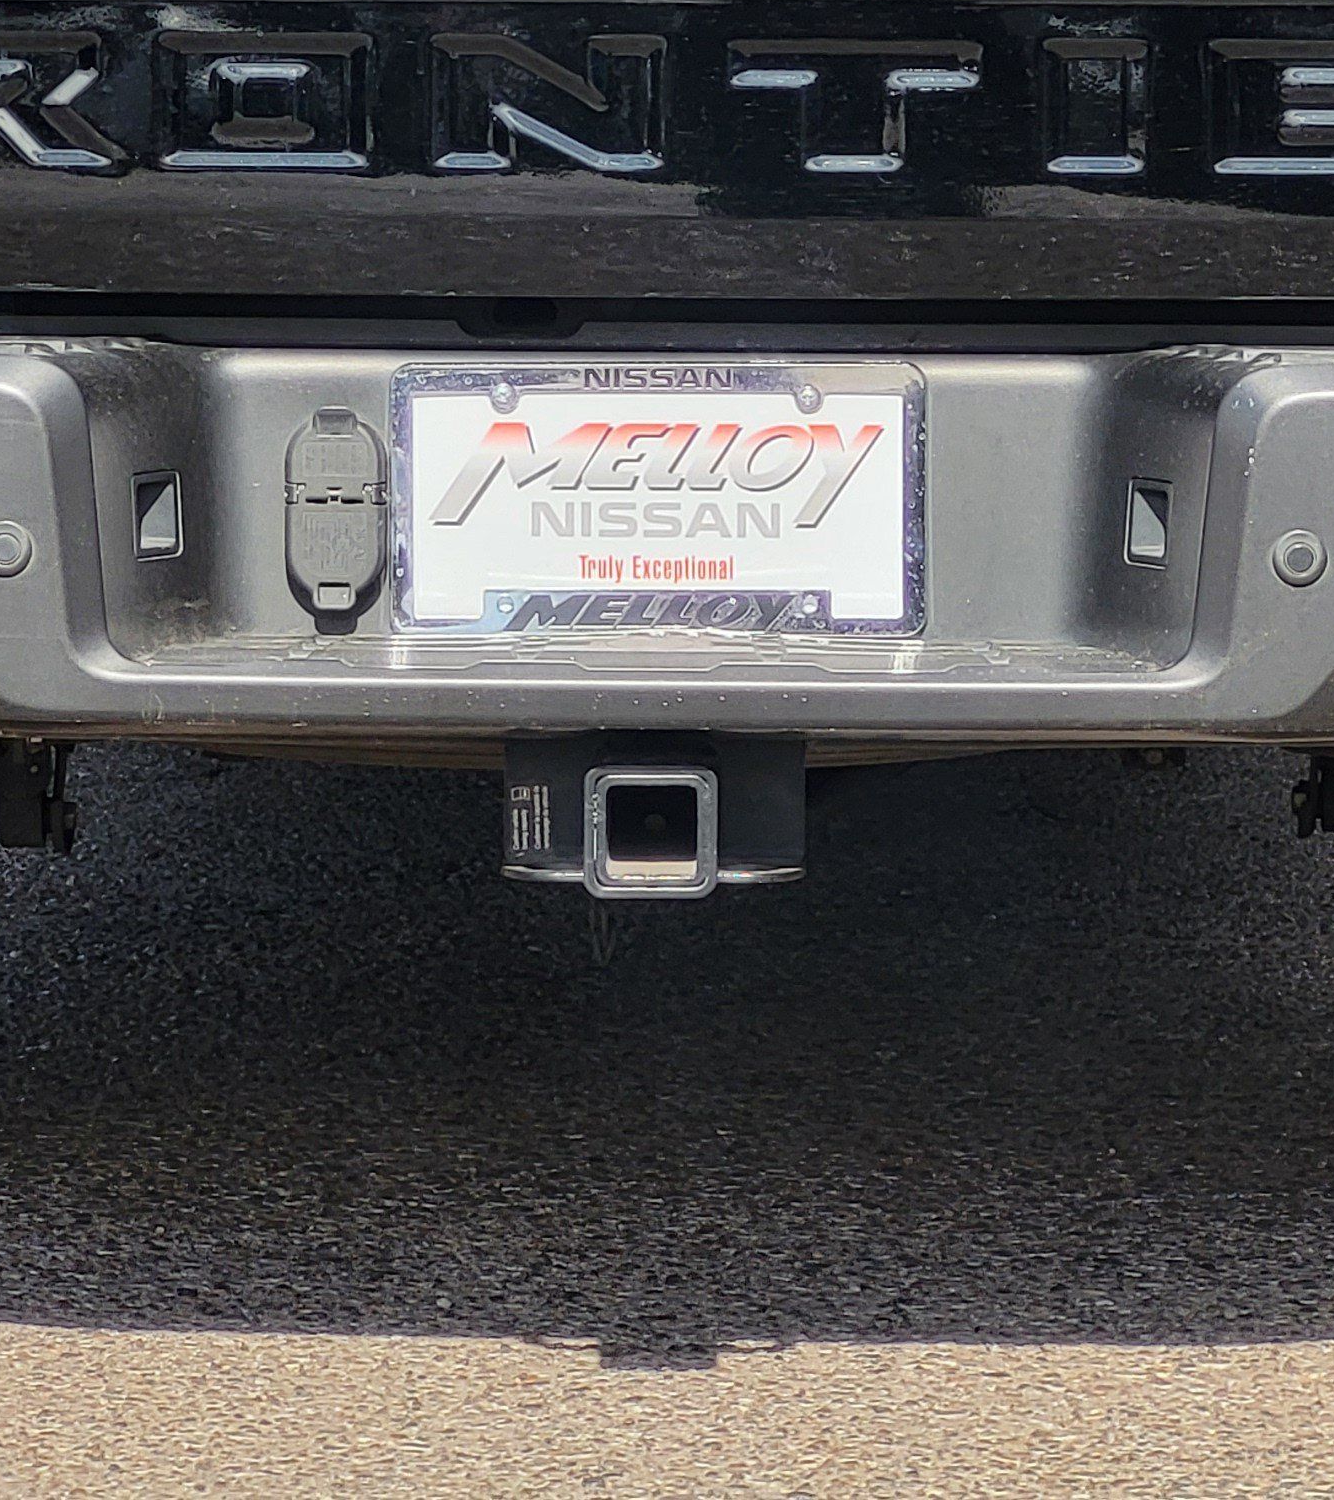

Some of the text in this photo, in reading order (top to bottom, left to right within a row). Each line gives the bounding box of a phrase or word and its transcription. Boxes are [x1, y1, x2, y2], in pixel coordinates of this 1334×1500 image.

[582, 367, 735, 391] NISSAN
[428, 421, 885, 529] MELLOY
[531, 501, 782, 540] NISSAN
[578, 554, 735, 584] Truly Exceptional
[500, 592, 803, 632] MELLOY
